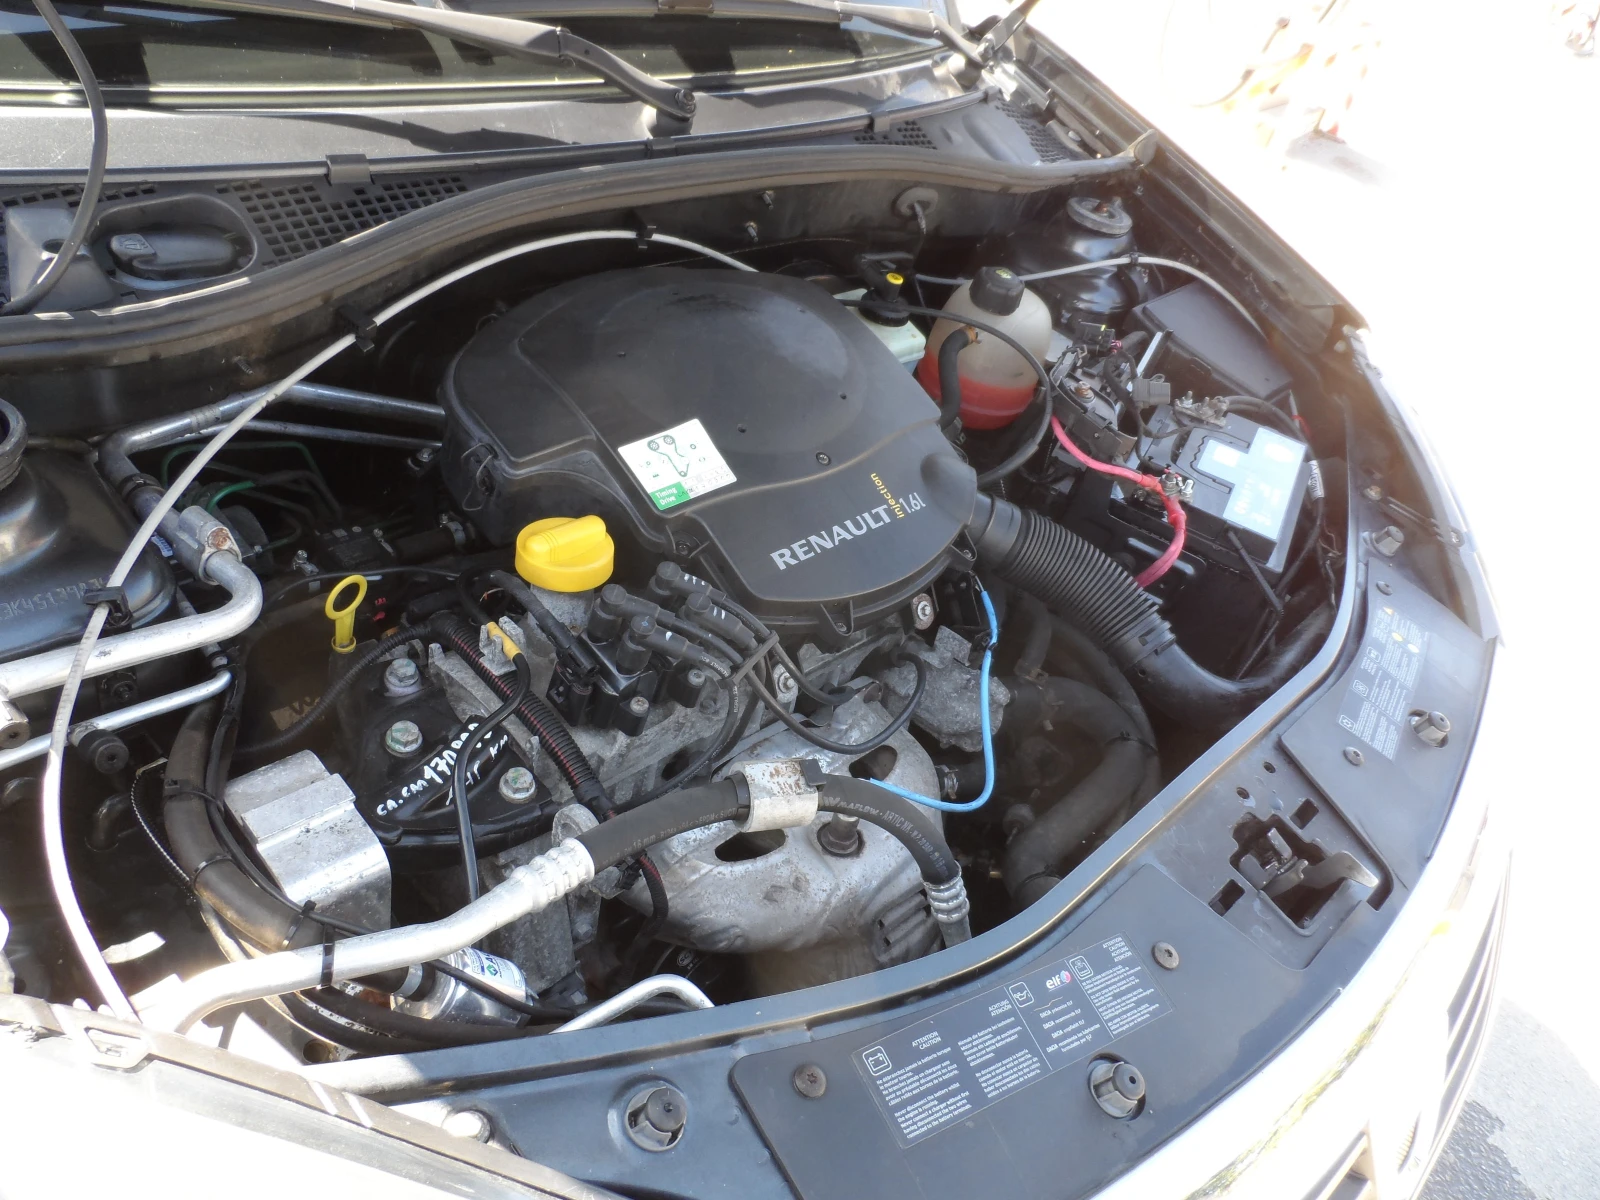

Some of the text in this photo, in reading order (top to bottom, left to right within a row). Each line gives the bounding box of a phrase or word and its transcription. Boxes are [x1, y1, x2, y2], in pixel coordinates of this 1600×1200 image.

[655, 487, 678, 499] Timing
[870, 473, 905, 518] injection
[660, 495, 677, 506] Drive
[769, 504, 891, 570] RENAULT
[881, 810, 905, 828] ARTIC
[633, 838, 642, 849] 16
[642, 834, 656, 846] mm
[1102, 937, 1122, 948] ATTENTION
[1108, 941, 1125, 951] CAUTION
[1111, 946, 1128, 956] ACHTUNG
[1046, 974, 1060, 988] elf
[988, 999, 1009, 1011] ACHTUNG
[991, 1002, 1012, 1016] ATENCIÓN
[1039, 1009, 1051, 1018] DACIA
[1042, 1020, 1055, 1029] DACIA
[912, 1031, 938, 1046] ATTENTION
[1051, 1029, 1063, 1038] DACIA
[919, 1036, 941, 1049] CAUTION
[1046, 1043, 1058, 1052] DACIA
